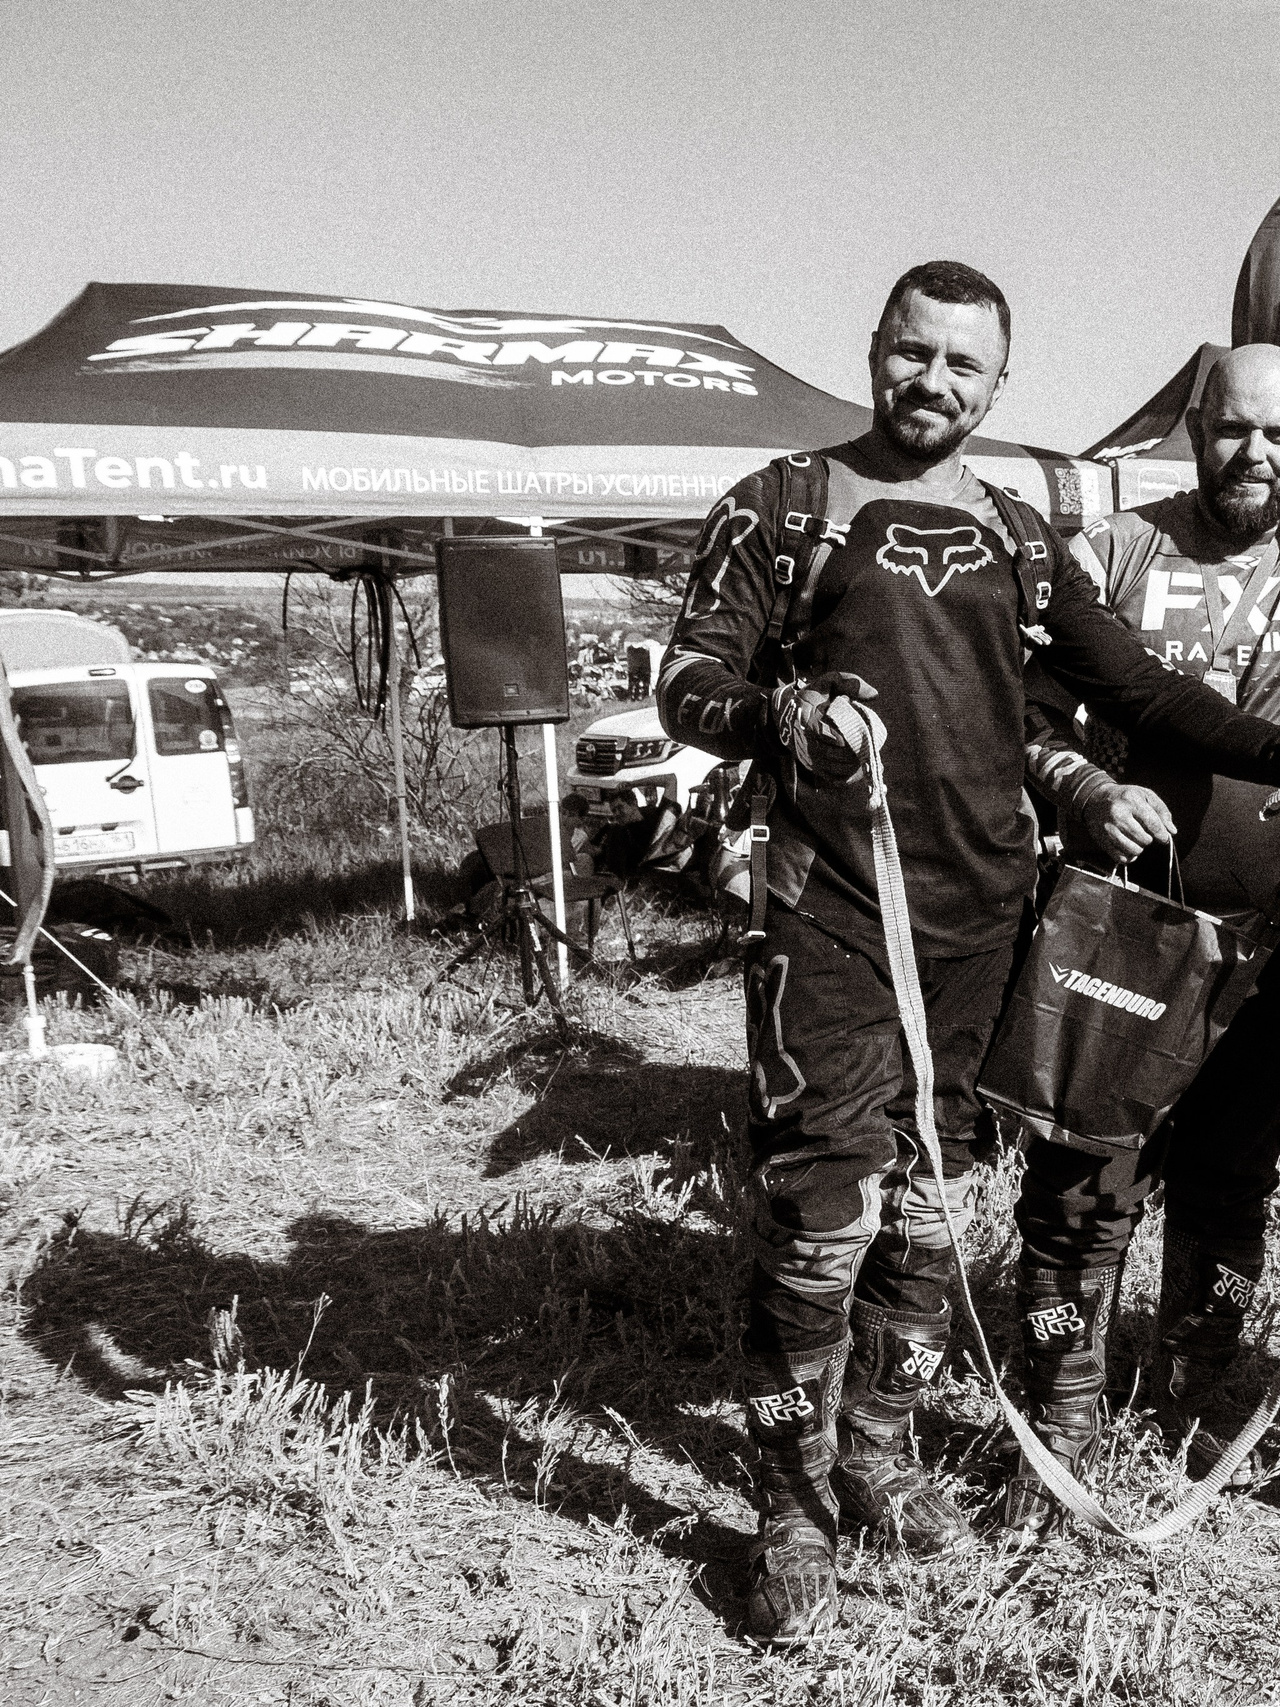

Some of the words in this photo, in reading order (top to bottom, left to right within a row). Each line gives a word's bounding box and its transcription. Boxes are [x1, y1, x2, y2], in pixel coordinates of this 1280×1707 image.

[87, 321, 758, 381] SHARMAX
[551, 369, 759, 396] MOTORS
[301, 466, 491, 494] МОБИЛЬНЫЕ
[498, 470, 594, 496] ШАТРЫ
[599, 473, 744, 498] УСИЛЕННО
[1164, 640, 1252, 667] RAE
[1063, 969, 1167, 1021] TAGENDURO
